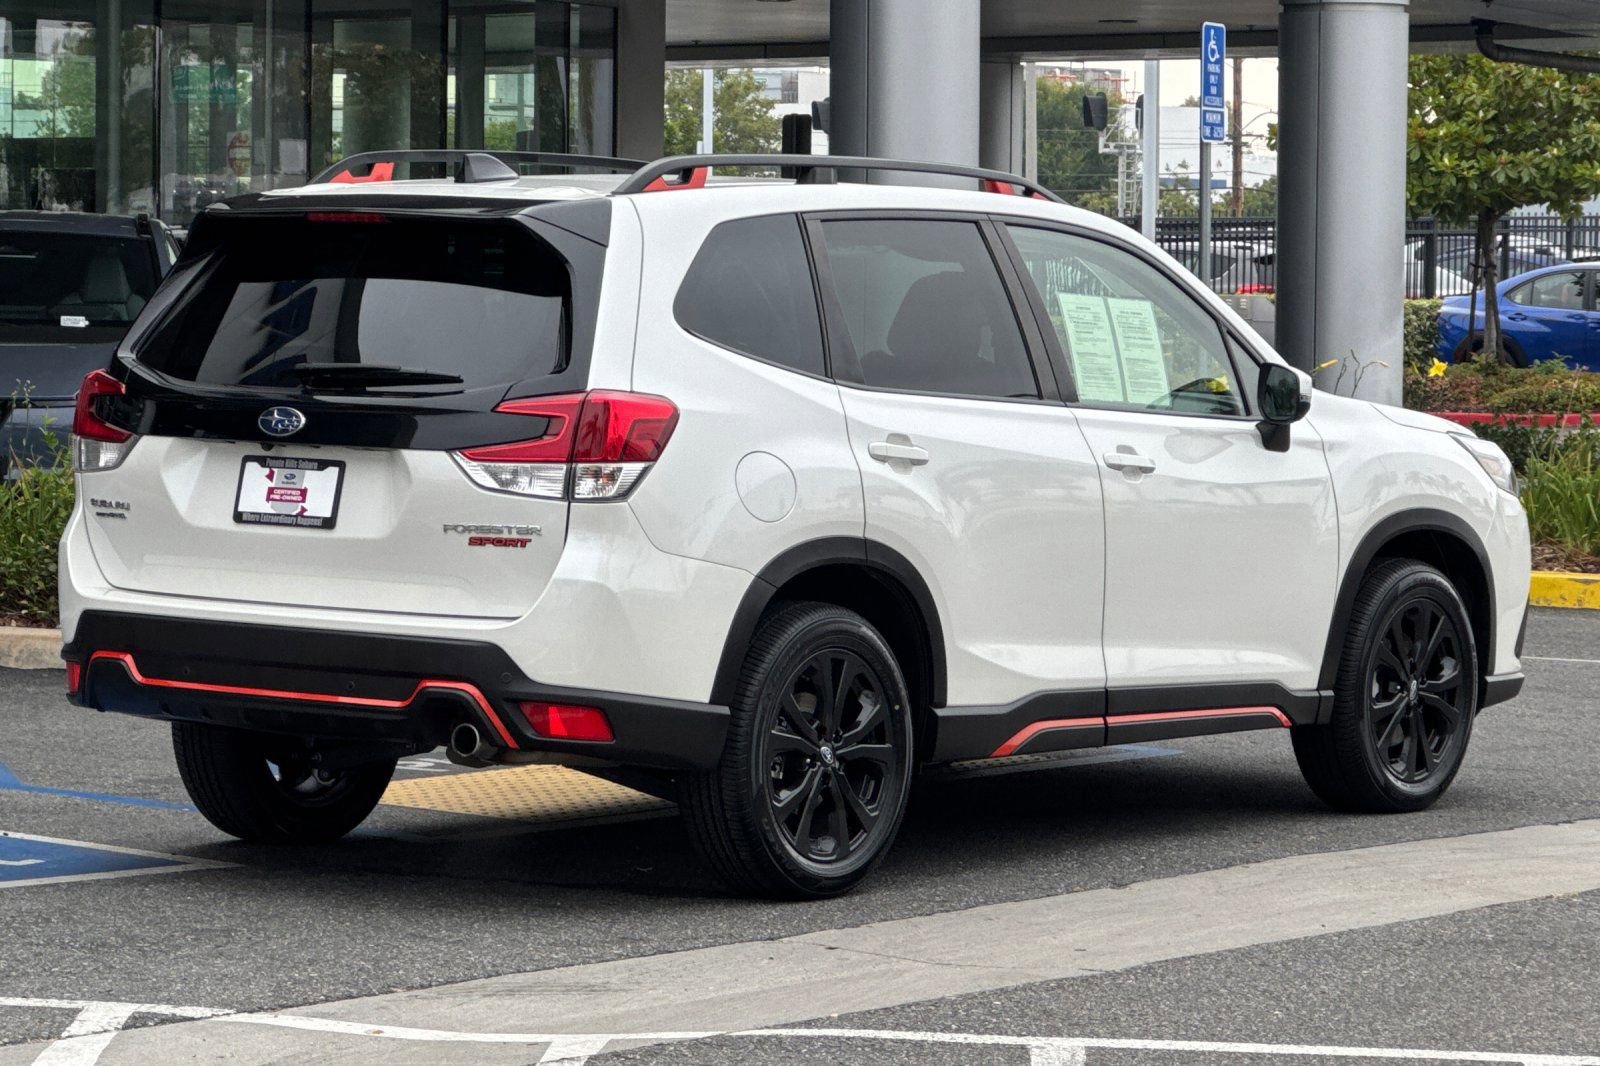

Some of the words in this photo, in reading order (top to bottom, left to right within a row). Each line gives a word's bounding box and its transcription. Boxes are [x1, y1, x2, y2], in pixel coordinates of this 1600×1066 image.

[298, 459, 318, 470] Subaru
[269, 494, 302, 502] PRE-OWNED
[273, 488, 301, 496] CERTIFIED
[90, 498, 131, 511] SUBARU
[242, 511, 259, 522] Where
[260, 513, 297, 526] Extraordinary
[443, 523, 543, 537] FORESTER
[467, 536, 532, 548] SPORT
